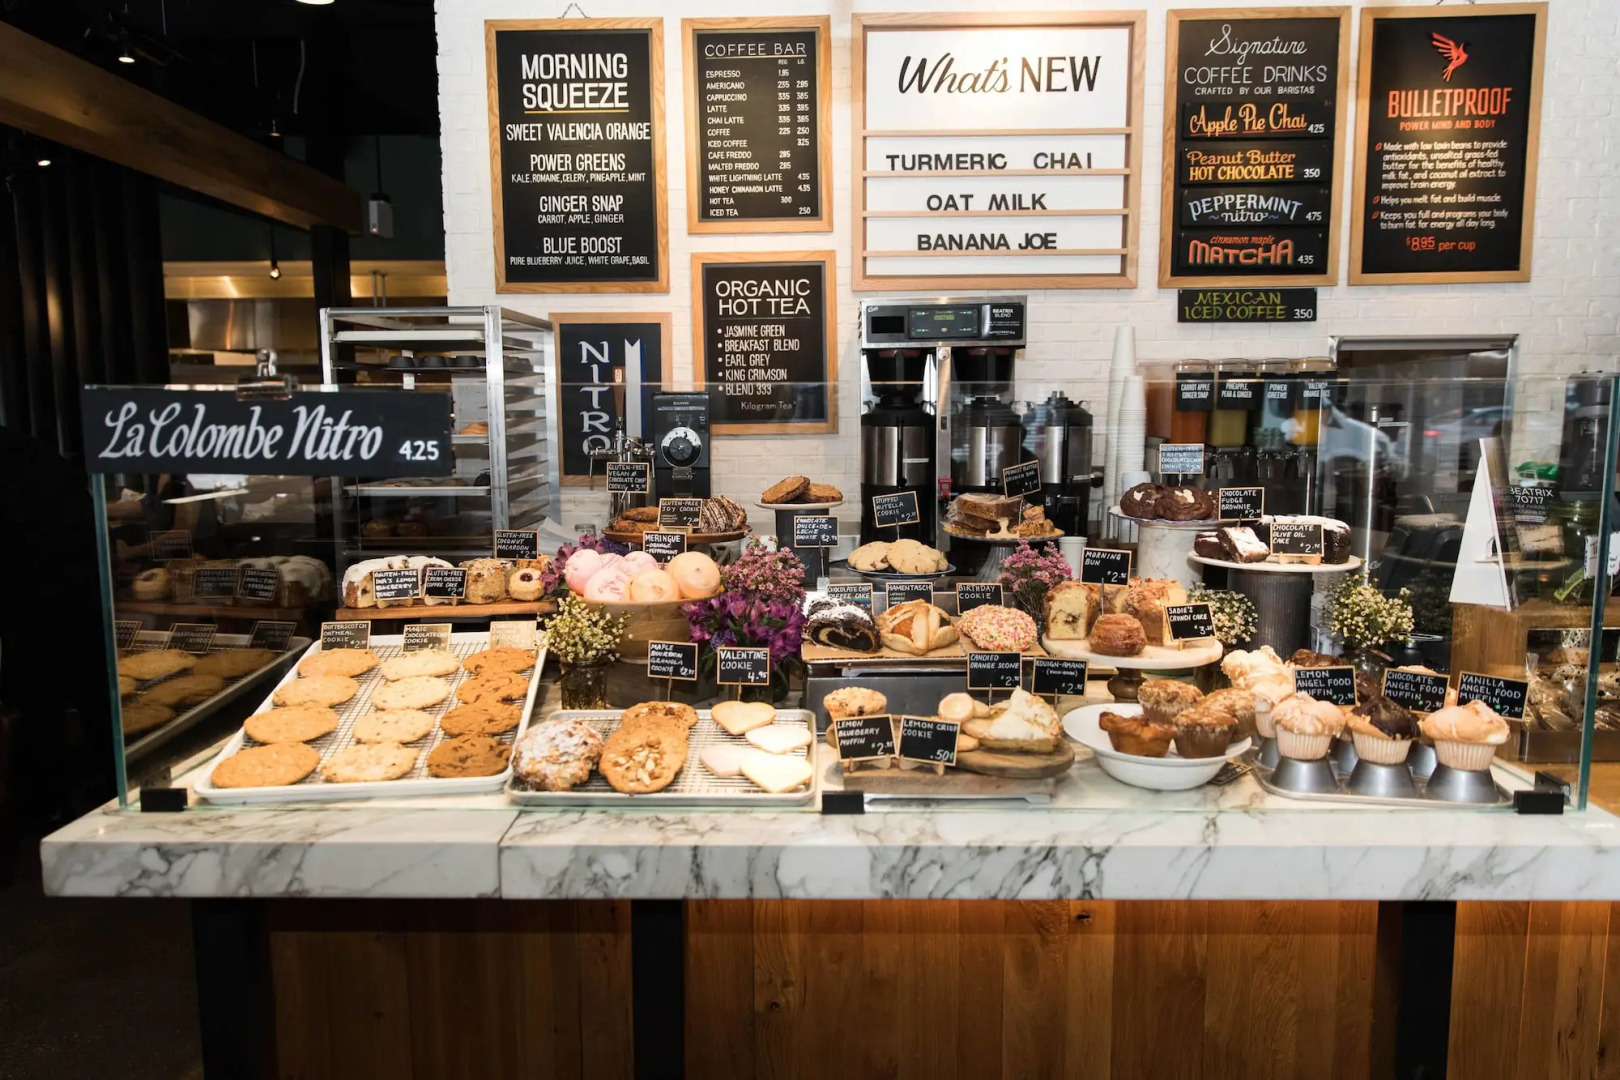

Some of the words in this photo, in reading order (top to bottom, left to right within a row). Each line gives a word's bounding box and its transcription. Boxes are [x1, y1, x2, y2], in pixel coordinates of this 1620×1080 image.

[704, 43, 767, 57] COFFEE
[774, 43, 806, 55] BAR
[1205, 24, 1307, 65] Signature
[521, 53, 628, 80] MORNING
[705, 70, 741, 78] ESPRESSO
[898, 52, 1012, 94] What's
[1020, 55, 1102, 93] NEW
[1184, 66, 1253, 85] COFFEE
[1264, 65, 1327, 84] DRINKS
[706, 82, 745, 90] AMERICANO
[1194, 87, 1233, 96] CRAFTED
[1239, 86, 1251, 95] BY
[1254, 86, 1272, 95] OUR
[1277, 86, 1315, 95] BARISTAS
[523, 82, 629, 111] SQUEEZE
[706, 93, 748, 102] CAPPUCCINO
[1387, 87, 1512, 118] BULLETPROOF
[706, 105, 728, 113] LATTE
[707, 117, 723, 125] CHAI
[724, 116, 744, 124] LATTE
[1189, 105, 1238, 137] Apple
[1239, 103, 1266, 131] Pie
[1269, 103, 1308, 130] Chai
[1399, 121, 1429, 132] POWER
[1431, 120, 1453, 131] MIND
[1455, 120, 1472, 130] AND
[1474, 119, 1496, 129] BODY
[506, 124, 542, 141] SWEET
[547, 123, 603, 141] VALENCIA
[606, 122, 651, 140] ORANGE
[707, 128, 730, 137] COFFEE
[707, 140, 722, 148] ICED
[722, 139, 748, 148] COFFEE
[708, 151, 725, 159] CAFE
[726, 151, 752, 159] FREDDO
[1186, 150, 1244, 165] Peanut
[1246, 149, 1296, 164] Butter
[530, 154, 572, 171] POWER
[576, 153, 626, 171] GREENS
[708, 163, 733, 171] MALTED
[734, 162, 760, 170] FREDDO
[886, 153, 1007, 171] TURMERIC
[1033, 152, 1092, 169] CHAI
[628, 173, 646, 182] MINT
[708, 174, 728, 182] WHITE
[729, 174, 763, 182] LIGHTNING
[763, 173, 783, 181] LATTE
[1189, 165, 1215, 182] HOT
[1217, 164, 1294, 181] CHOCOLATE
[709, 186, 730, 194] HONEY
[764, 185, 783, 193] LATTE
[539, 195, 588, 212] GINGER
[592, 195, 624, 212] SNAP
[709, 197, 722, 205] HOT
[722, 197, 735, 205] TEA
[927, 195, 974, 211] OAT
[988, 193, 1048, 210] MILK
[1380, 196, 1399, 206] Helps
[1430, 194, 1442, 204] fat
[1443, 194, 1457, 203] and
[1457, 193, 1476, 203] build
[709, 209, 725, 217] ICED
[726, 208, 739, 217] TEA
[1188, 194, 1303, 222] PEPPERMINT
[594, 214, 624, 223] GINGER
[1220, 209, 1268, 223] nitro
[543, 237, 576, 254] BLUE
[580, 237, 622, 253] BOOST
[917, 233, 1010, 251] BANANA
[1018, 233, 1057, 250] JOE
[1210, 235, 1249, 245] cinnamon
[1250, 235, 1276, 247] maple
[1438, 240, 1456, 251] per
[1458, 240, 1476, 251] cup
[1188, 240, 1293, 265] MATCHA
[510, 256, 526, 266] PURE
[527, 256, 562, 266] BLUEBERRY
[588, 256, 609, 265] WHITE
[632, 255, 650, 265] BASIL
[715, 279, 811, 297] ORGANIC
[1194, 292, 1282, 306] MEXICAN
[718, 298, 761, 315] HOT
[765, 297, 811, 315] TEA
[1184, 305, 1222, 320] ICED
[1226, 305, 1287, 319] COFFEE
[724, 325, 759, 338] JASMINE
[760, 325, 785, 337] GREEN
[725, 340, 770, 352] BREAKFAST
[773, 339, 800, 352] BLEND
[725, 354, 746, 367] EARL
[749, 354, 770, 366] GREY
[725, 369, 746, 381] KING
[748, 368, 788, 381] CRIMSON
[725, 383, 754, 396] BLEND
[756, 383, 772, 395] 333
[1269, 383, 1288, 391] POWER
[741, 401, 776, 411] Kilogram
[98, 401, 145, 459] La
[149, 402, 283, 459] Colombe
[286, 403, 383, 460] Nitro
[1221, 489, 1257, 497] CHOCOLATE
[1515, 495, 1544, 504] 70717
[1272, 524, 1314, 532] CHOCOLATE
[644, 534, 681, 544] MERINGUE
[1272, 537, 1290, 545] CAKE
[1085, 551, 1122, 561] MORNING
[1084, 558, 1101, 566] BUN
[887, 584, 932, 592] HAMENTASCH
[958, 584, 995, 593] BIRTHDAY
[958, 592, 992, 600] COOKIE
[1168, 605, 1194, 615] SADIE'S
[323, 623, 367, 631] BUTTERSCOTCH
[720, 650, 767, 660] VALENTINE
[970, 653, 999, 662] CANDIED
[650, 665, 674, 673] COOKIE
[720, 661, 753, 670] COOKIE
[1295, 670, 1329, 679] LEMON
[1386, 672, 1435, 685] CHOCOLATE
[1296, 679, 1326, 688] ANGEL
[1327, 677, 1352, 686] FOOD
[1461, 674, 1505, 688] VANILLA
[1385, 681, 1416, 692] ANGEL
[1419, 684, 1445, 695] FOOD
[1460, 683, 1491, 695] ANGEL
[1494, 688, 1521, 699] FOOD
[1384, 689, 1422, 701] MUFFIN
[837, 720, 864, 729] LEMON
[903, 719, 934, 730] LEMON
[936, 723, 958, 732] CRISP
[838, 727, 880, 738] BLUEBERRY
[902, 728, 933, 739] COOKIE
[839, 737, 866, 746] MUFFIN
